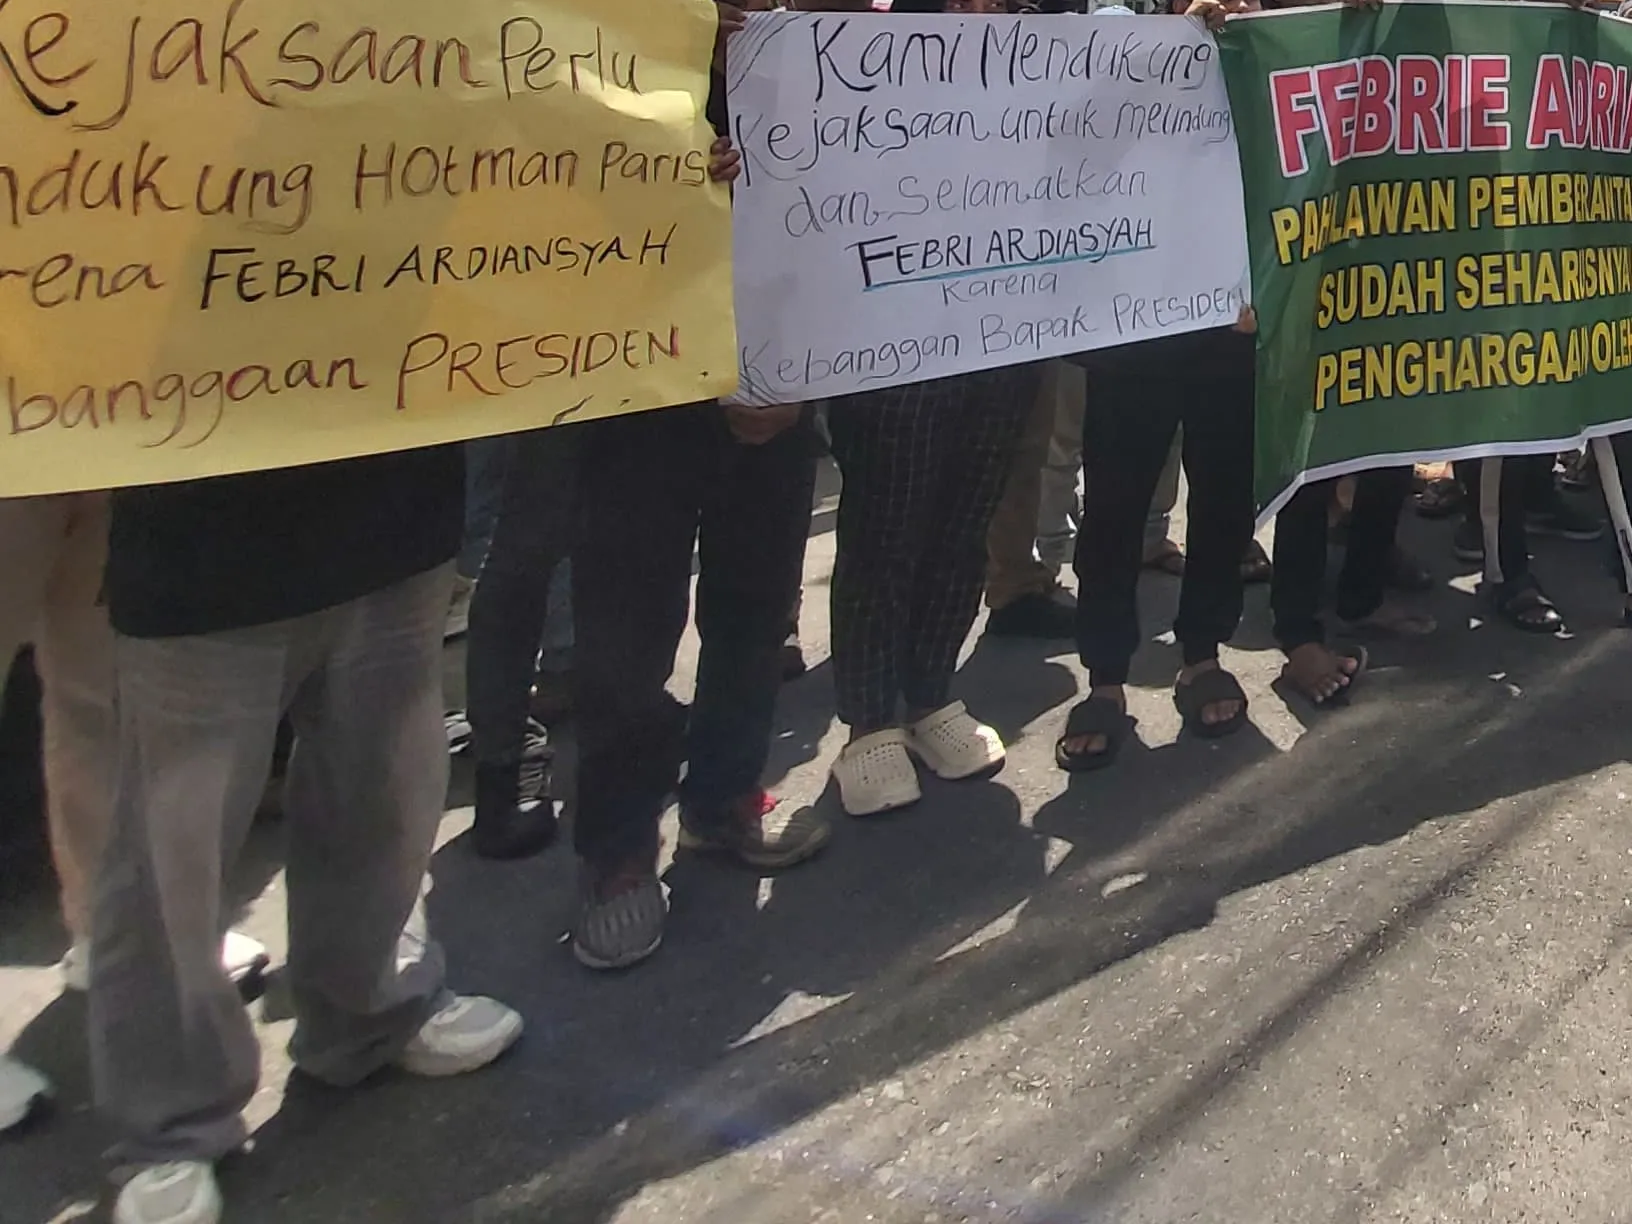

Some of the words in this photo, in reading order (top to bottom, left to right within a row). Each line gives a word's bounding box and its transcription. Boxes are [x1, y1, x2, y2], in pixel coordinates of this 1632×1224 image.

[499, 16, 640, 100] Perlu
[811, 18, 966, 101] Kami
[979, 19, 1212, 91] Mendukung
[733, 103, 990, 186] Kejaksaan
[1001, 96, 1102, 142] untuk
[1269, 53, 1511, 178] FEBRIE
[600, 141, 706, 193] Paris
[784, 185, 879, 238] dan
[846, 233, 972, 287] FEBRI
[985, 217, 1153, 263] ARDIASYAH
[1271, 178, 1456, 265] PAHLAWAN
[0, 253, 166, 308] ena
[200, 247, 366, 310] FEBRI
[383, 222, 678, 286] ARDIANSYAH
[1316, 258, 1446, 329] SUDAH
[1455, 244, 1631, 311] SEHARUSNYA
[396, 325, 681, 410] PRESIDEN
[980, 305, 1098, 356] Bapak
[1315, 324, 1589, 410] PENGHARGAAN
